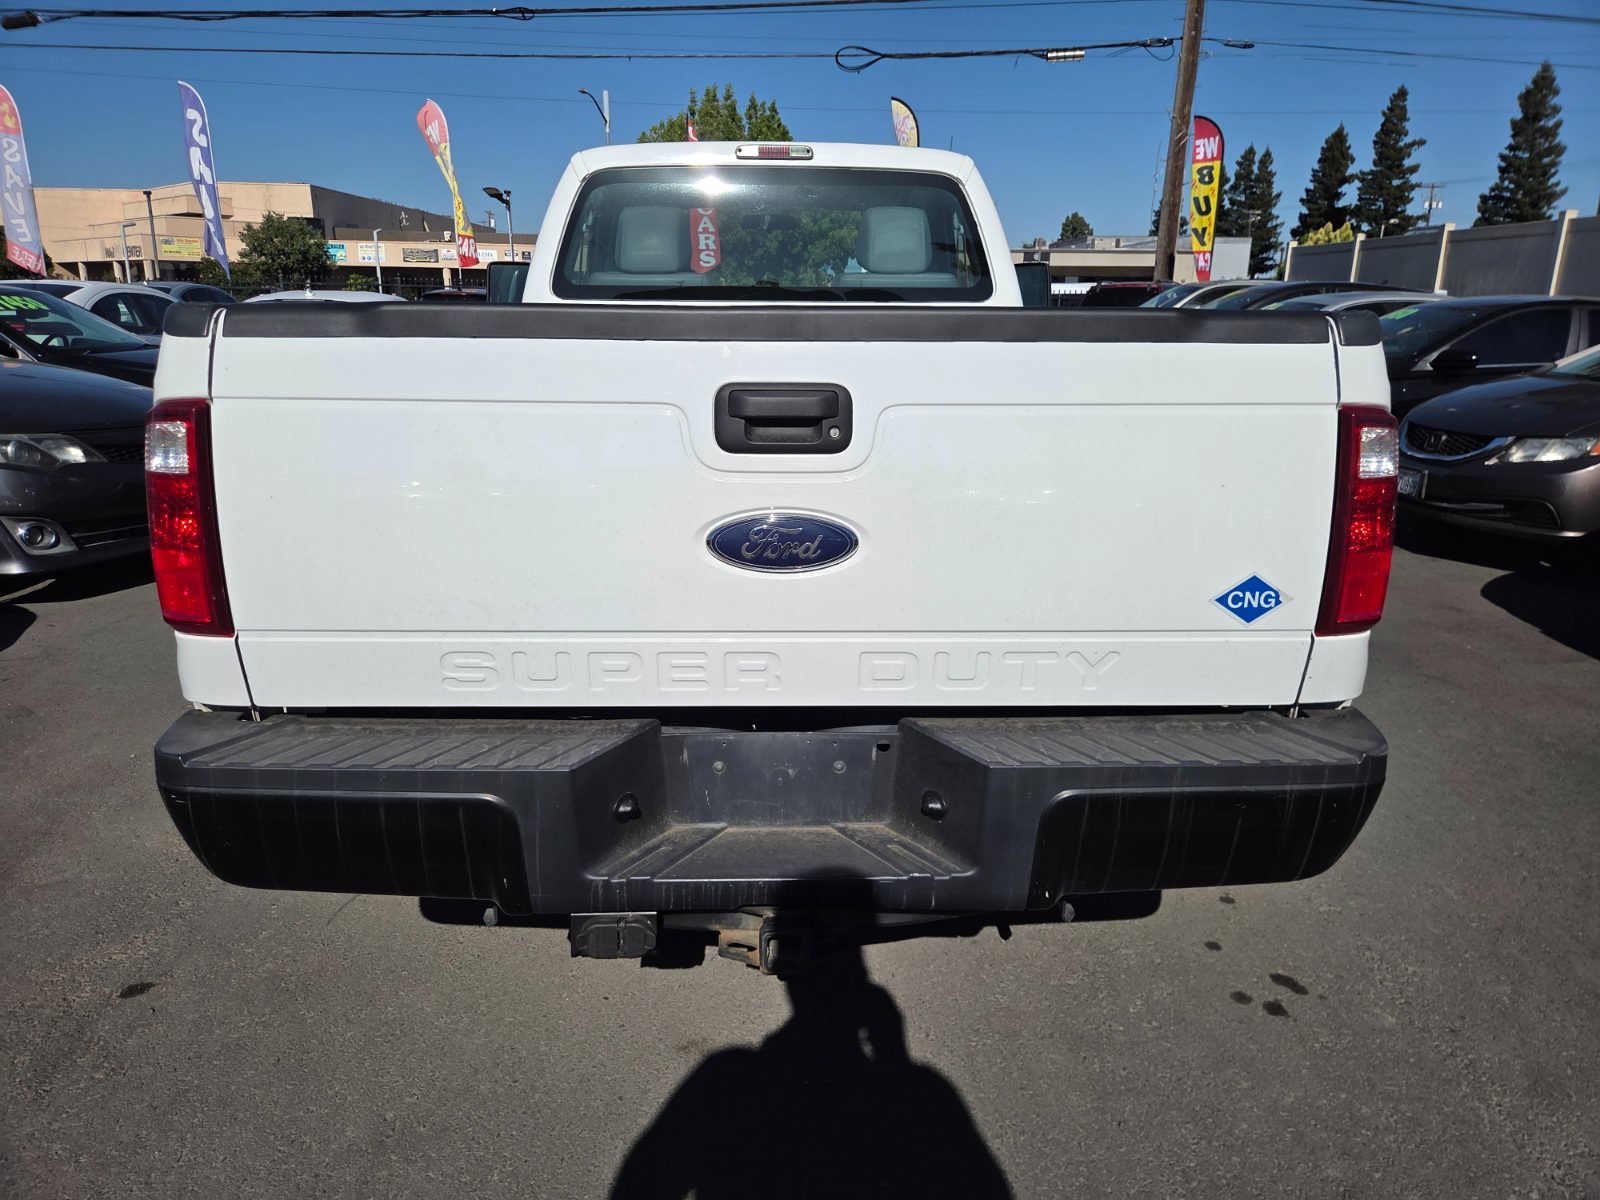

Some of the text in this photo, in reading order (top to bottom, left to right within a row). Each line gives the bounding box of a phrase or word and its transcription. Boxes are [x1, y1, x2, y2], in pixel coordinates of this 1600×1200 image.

[741, 525, 823, 559] Ford
[1228, 591, 1276, 608] CNG
[439, 651, 1121, 691] SUPER DUTY
